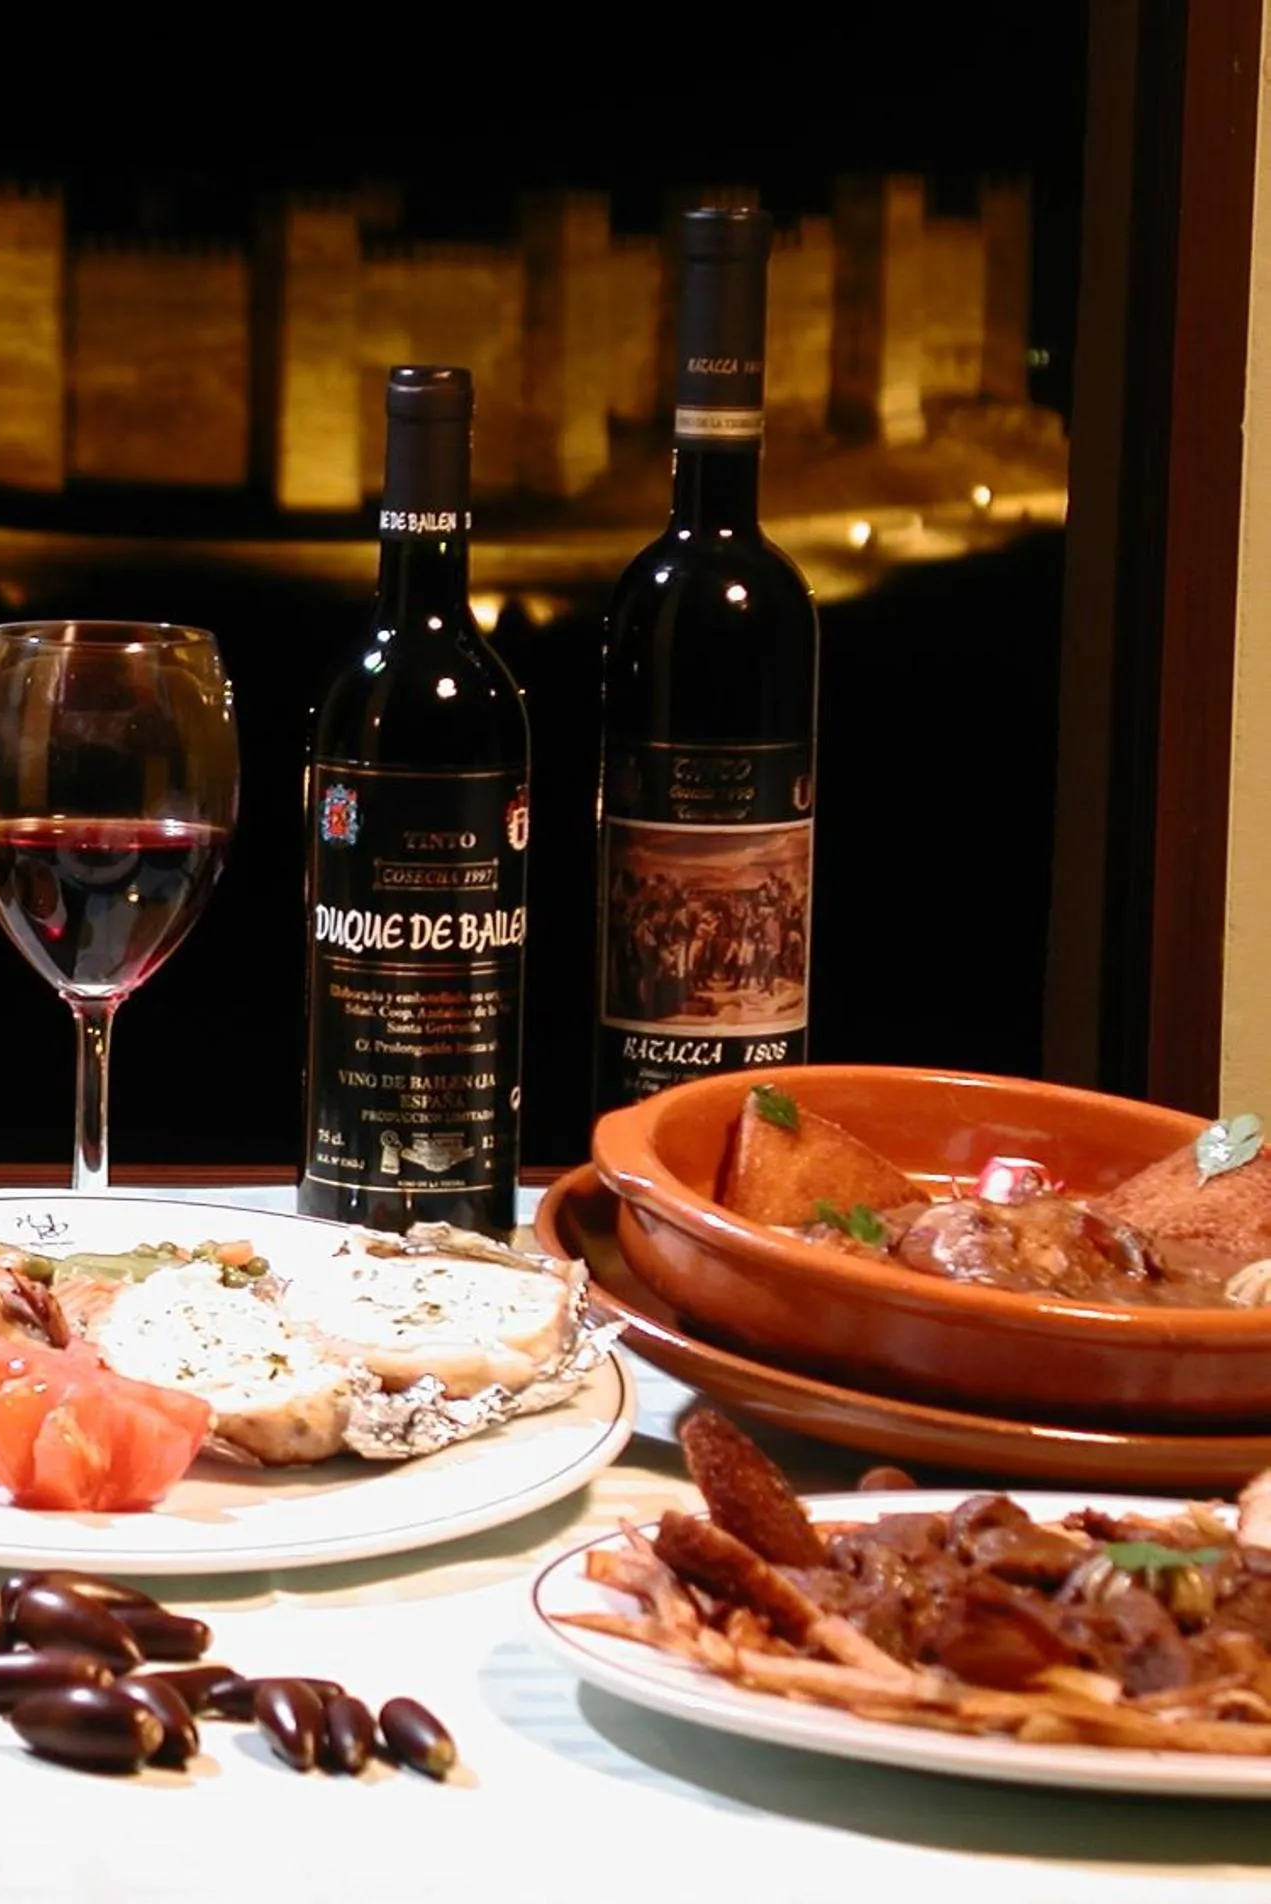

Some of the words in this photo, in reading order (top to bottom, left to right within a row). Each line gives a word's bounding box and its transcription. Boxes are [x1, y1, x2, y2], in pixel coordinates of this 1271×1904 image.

[404, 831, 477, 849] TINTO
[382, 868, 458, 884] COSECHA
[463, 869, 493, 883] 1997
[315, 903, 404, 954] DUQUE
[409, 913, 453, 951] DE
[338, 1070, 377, 1088] VINO
[381, 1074, 406, 1089] DE
